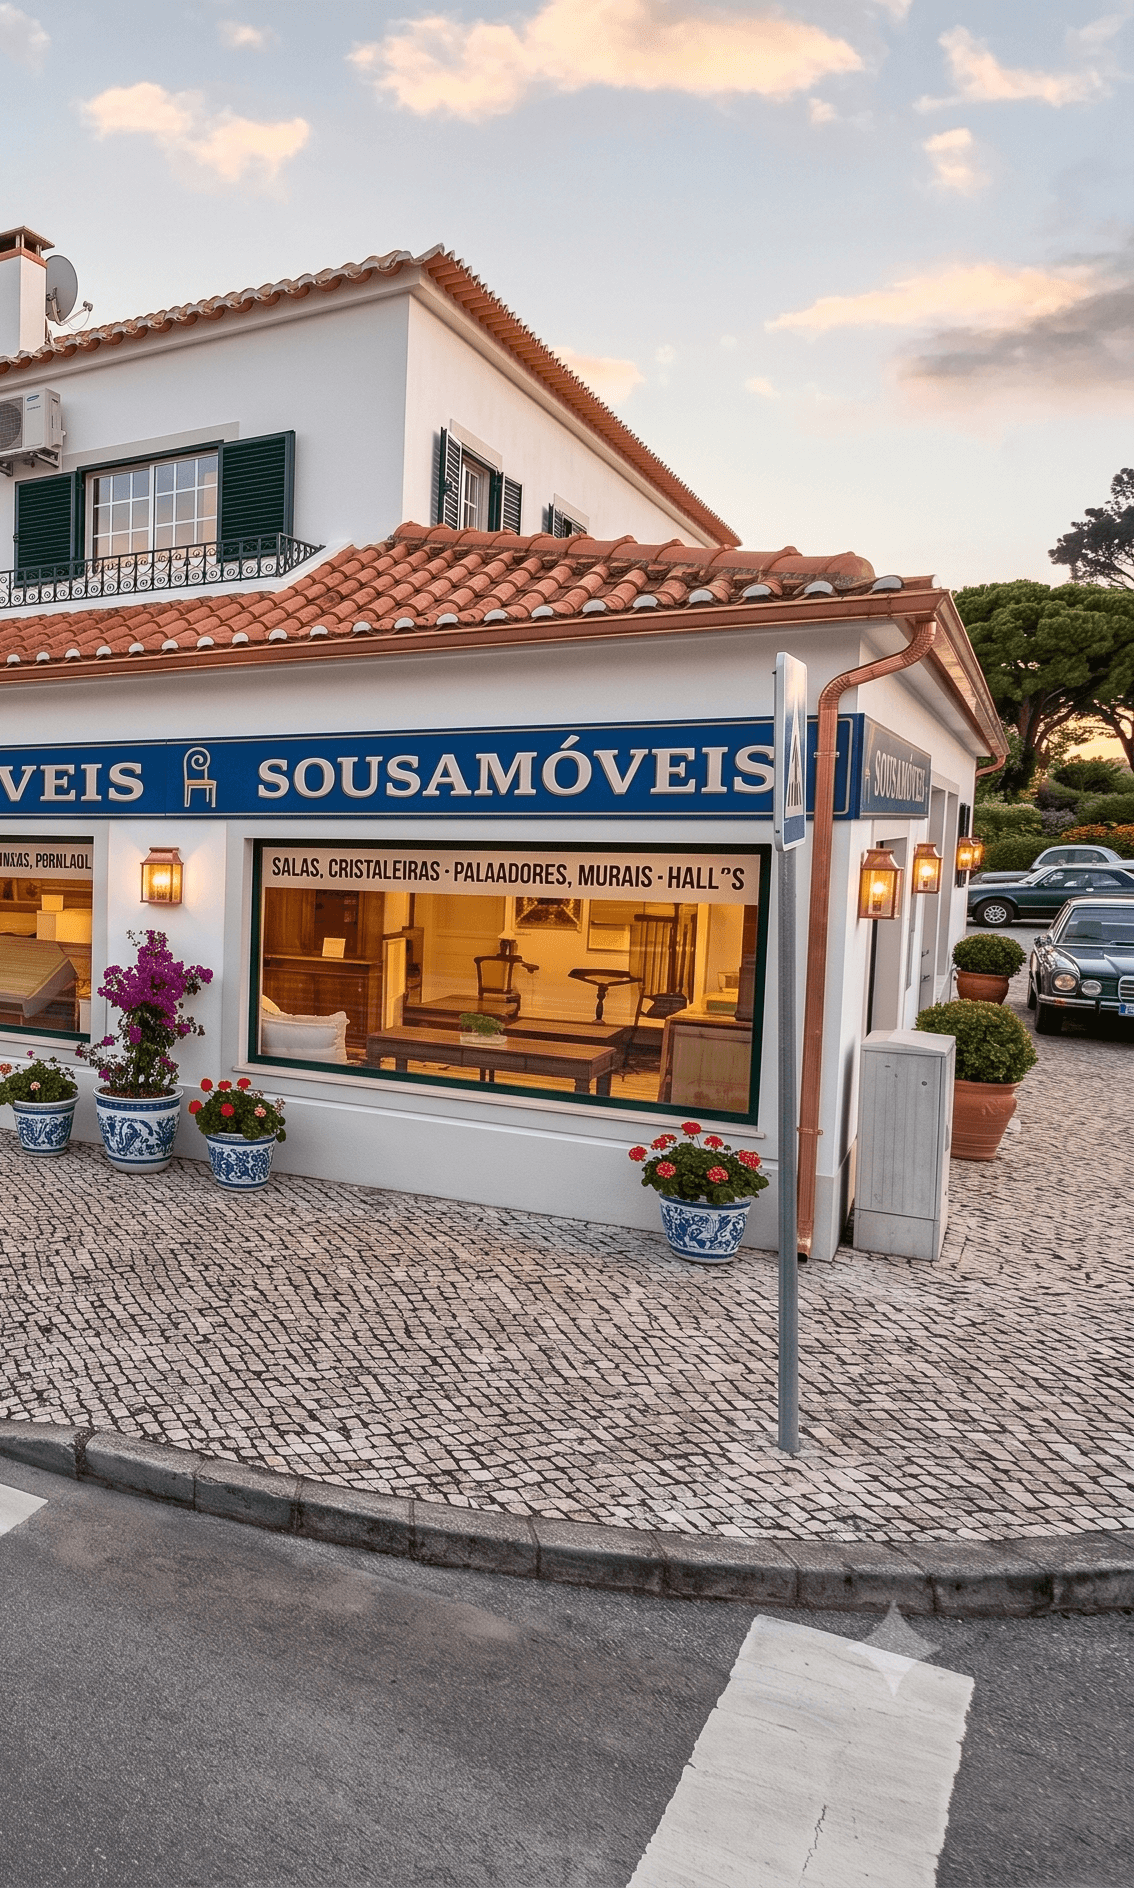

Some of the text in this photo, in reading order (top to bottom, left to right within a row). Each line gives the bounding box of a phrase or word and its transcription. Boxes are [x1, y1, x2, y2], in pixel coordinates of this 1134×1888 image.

[257, 735, 775, 799] SOUSAMÓVEIS
[272, 856, 324, 879] SALAS,
[328, 858, 441, 881] CRISTALEIRAS
[453, 861, 572, 888] PALAADORES,
[578, 864, 653, 888] MURAIS
